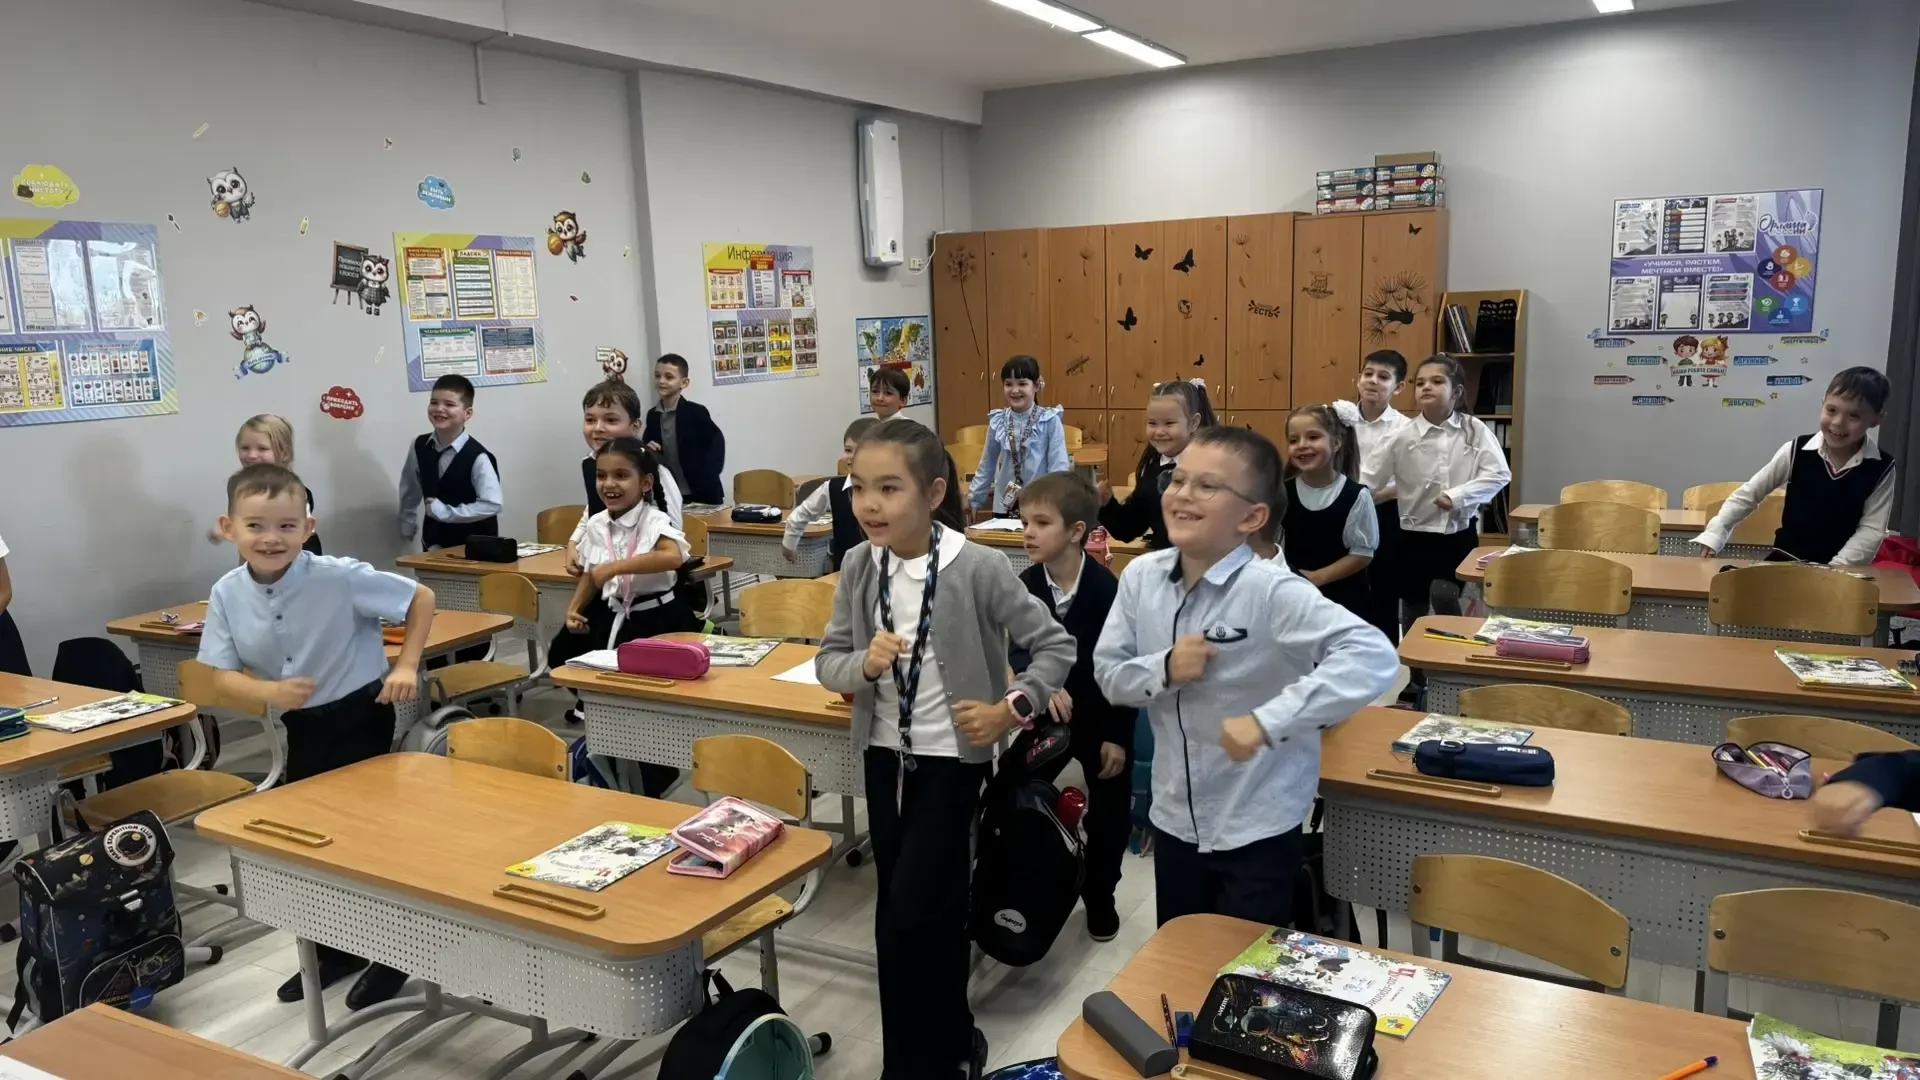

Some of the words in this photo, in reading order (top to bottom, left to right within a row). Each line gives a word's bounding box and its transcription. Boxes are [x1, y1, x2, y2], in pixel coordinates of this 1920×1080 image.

[1641, 267, 1682, 275] МЕЧТАЕМ
[1254, 306, 1274, 318] ЕСТЬ
[107, 825, 139, 845] EXPEDITION
[140, 827, 153, 839] CLUB
[1364, 967, 1417, 1008] Чудо-пропис
